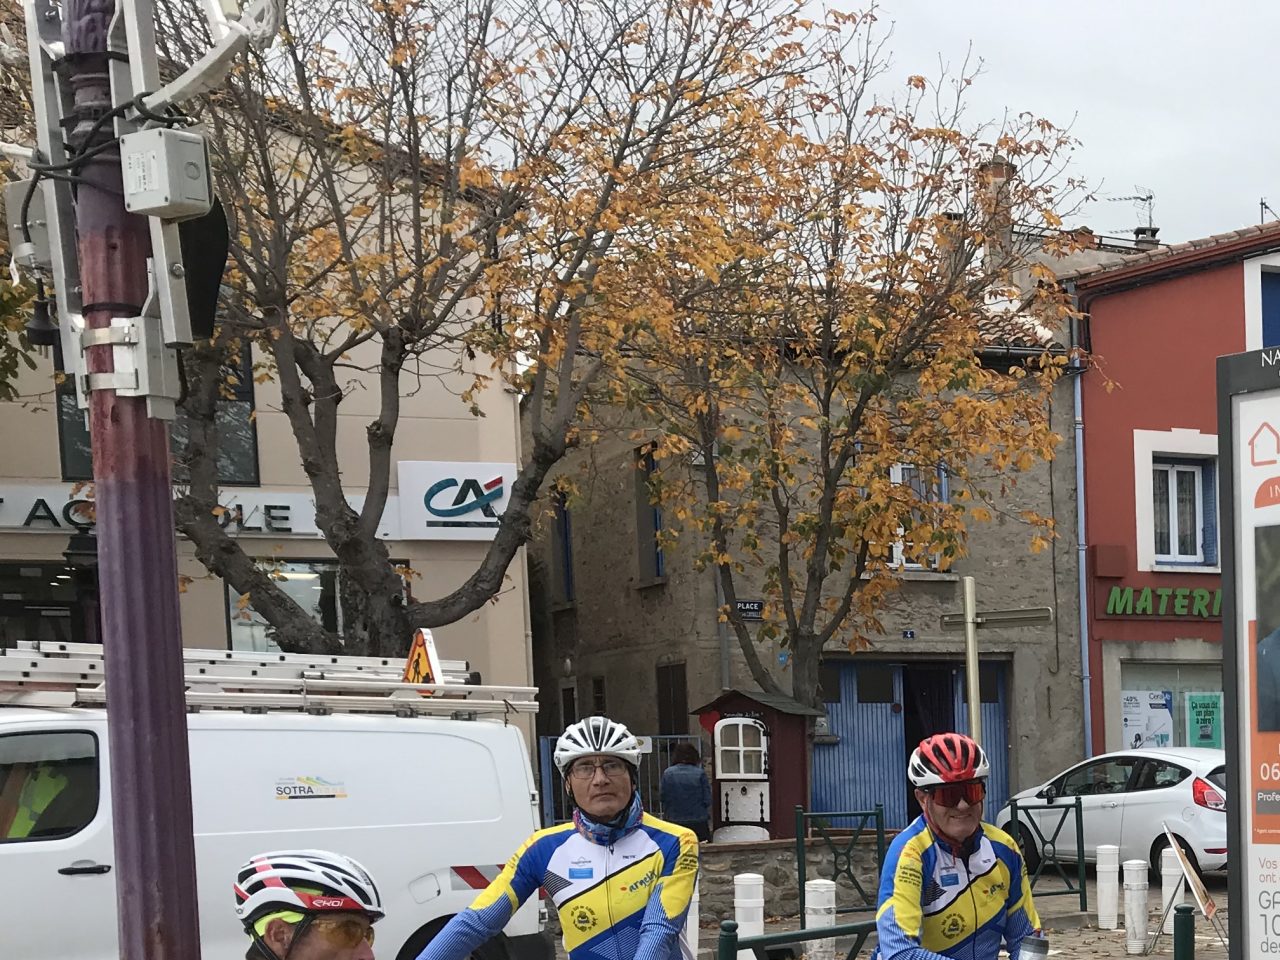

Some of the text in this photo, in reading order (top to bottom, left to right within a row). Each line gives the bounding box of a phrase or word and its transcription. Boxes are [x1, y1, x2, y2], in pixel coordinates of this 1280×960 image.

[737, 602, 759, 610] PLACE
[1106, 586, 1222, 618] MATERI
[1203, 710, 1214, 718] plan
[1258, 857, 1278, 870] Vos
[1259, 873, 1277, 883] ont
